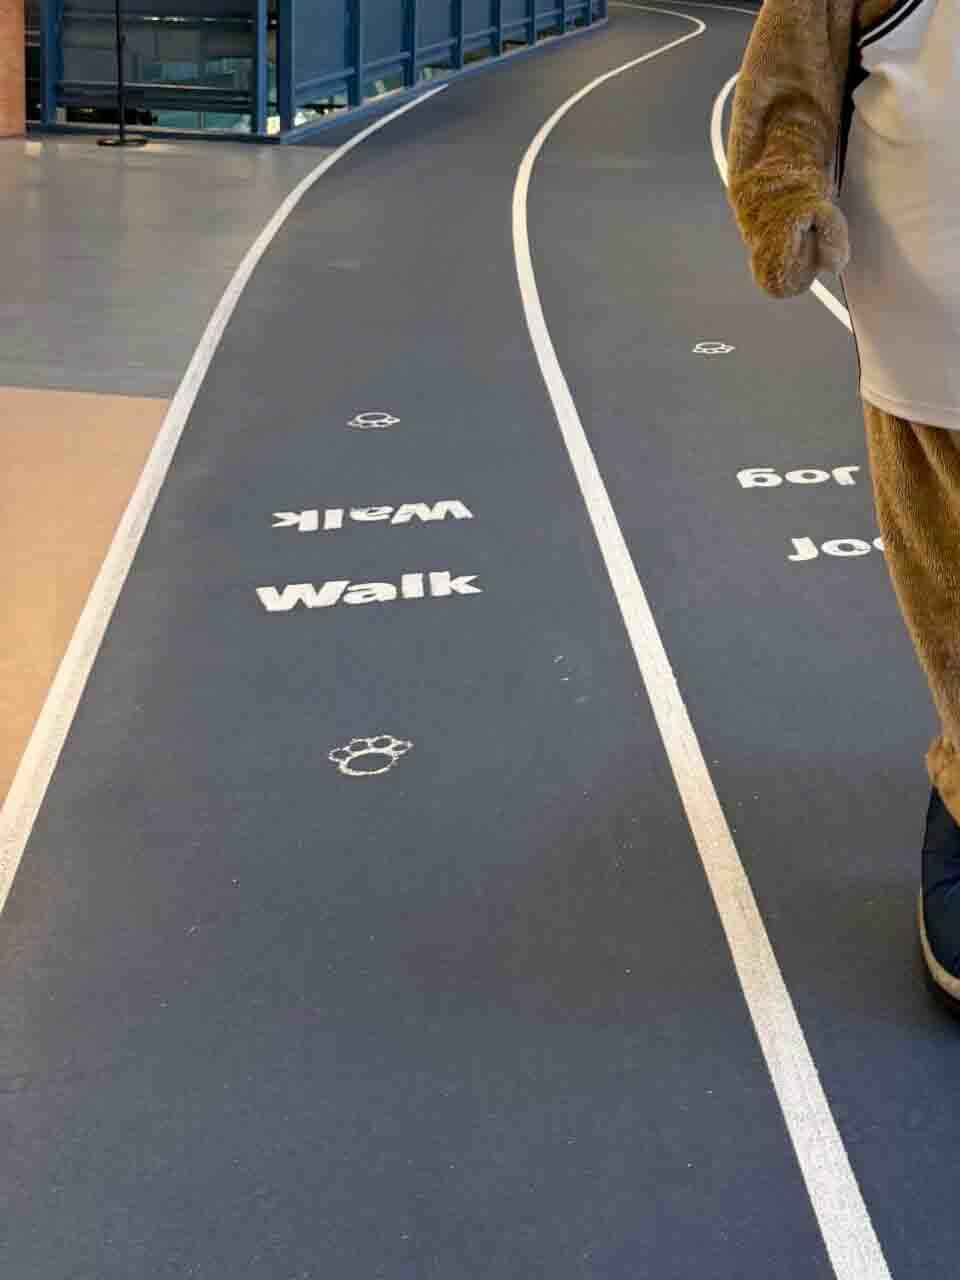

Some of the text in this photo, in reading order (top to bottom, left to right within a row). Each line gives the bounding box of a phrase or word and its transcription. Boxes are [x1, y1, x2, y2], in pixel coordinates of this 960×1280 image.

[736, 465, 861, 489] Jog
[271, 499, 474, 532] Walk
[787, 536, 886, 562] Jo
[256, 571, 484, 612] Walk
